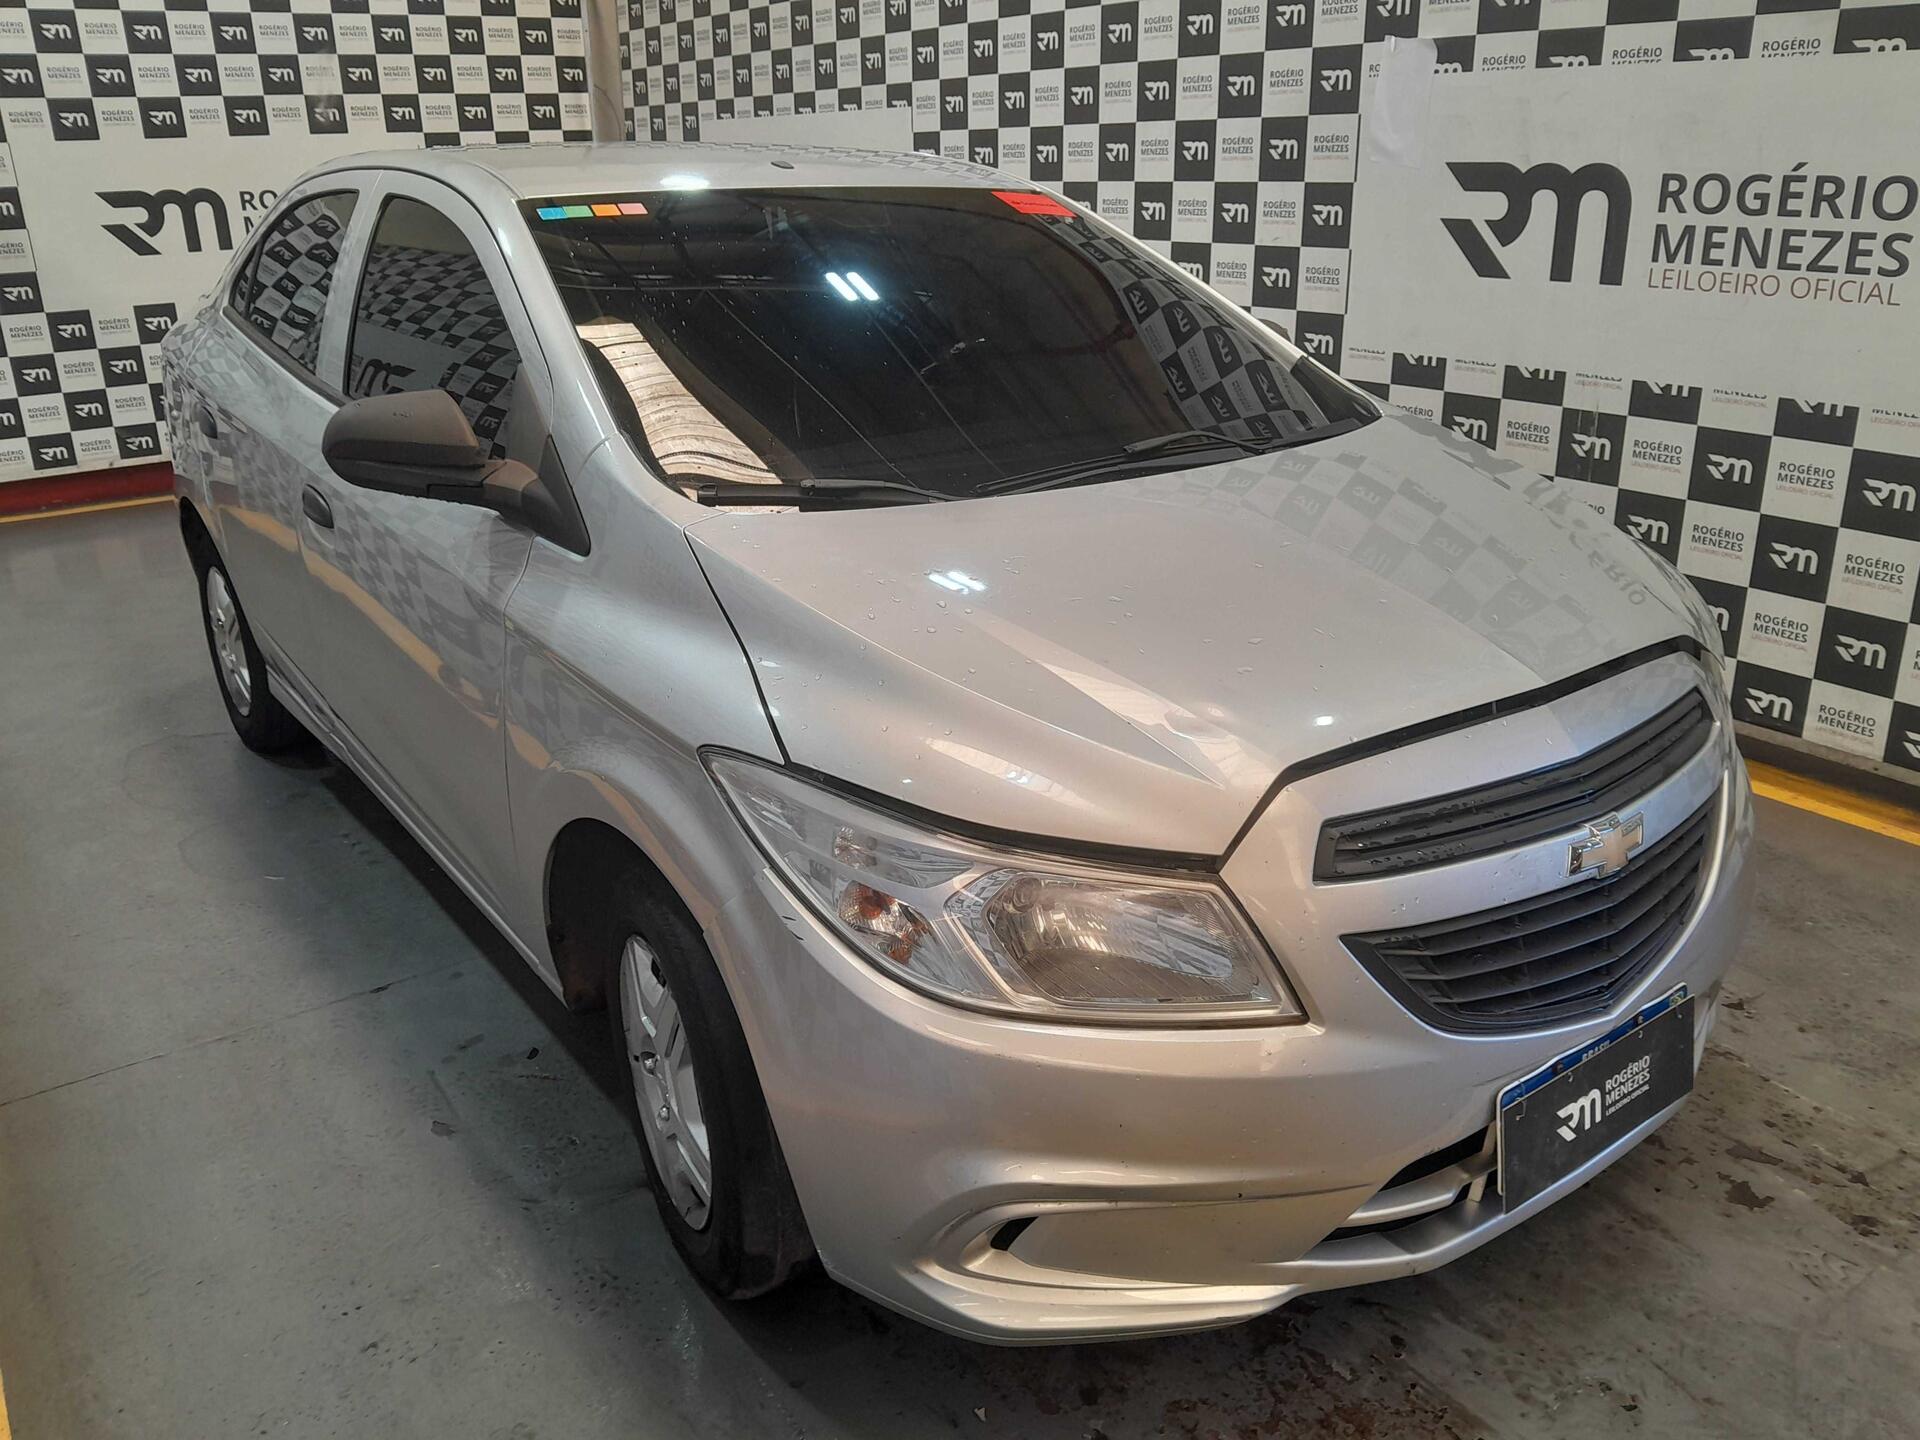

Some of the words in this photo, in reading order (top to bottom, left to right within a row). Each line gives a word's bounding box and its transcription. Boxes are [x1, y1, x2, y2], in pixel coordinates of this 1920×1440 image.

[1228, 6, 1260, 16] ROGÉRIO
[1321, 5, 1358, 16] MENEZES
[1144, 15, 1173, 25] ROGÉRIO
[1227, 15, 1260, 25] MENEZES
[1070, 24, 1095, 34] ROGÉRIO
[1144, 22, 1173, 33] MENEZES
[1003, 32, 1025, 41] ROGÉRIO
[1070, 32, 1095, 42] MENEZES
[1003, 40, 1025, 48] MENEZES
[1761, 37, 1821, 51] ROGÉRIO
[1612, 46, 1662, 60] ROGÉRIO
[1482, 54, 1526, 66] ROGÉRIO
[1270, 69, 1303, 78] ROGÉRIO
[1105, 80, 1131, 89] ROGÉRIO
[1183, 75, 1212, 84] ROGÉRIO
[1270, 78, 1303, 88] MENEZES
[1035, 86, 1059, 94] ROGÉRIO
[1182, 84, 1212, 92] MENEZES
[1141, 139, 1169, 147] ROGÉRIO
[1222, 136, 1253, 145] ROGÉRIO
[1314, 135, 1349, 144] ROGÉRIO
[1313, 143, 1349, 153] MENEZES
[1658, 162, 1918, 222] ROGÉRIO
[1102, 198, 1128, 206] ROGÉRIO
[1178, 199, 1207, 207] ROGÉRIO
[1264, 200, 1296, 209] ROGÉRIO
[1102, 206, 1128, 214] MENEZES
[1263, 210, 1296, 218] MENEZES
[1650, 224, 1914, 277] MENEZES
[1217, 260, 1247, 271] ROGÉRIO
[1216, 270, 1247, 279] MENEZES
[1306, 266, 1340, 276] ROGÉRIO
[1305, 276, 1340, 286] MENEZES
[1648, 268, 1780, 297] LEILOEIRO
[1790, 276, 1902, 306] OFICIAL
[1507, 420, 1550, 435] ROGÉRIO
[1506, 430, 1549, 444] MENEZES
[1634, 440, 1682, 454] ROGÉRIO
[1632, 450, 1681, 465] MENEZES
[1779, 462, 1835, 478] ROGÉRIO
[1778, 473, 1834, 490] MENEZES
[1693, 524, 1744, 541] ROGÉRIO
[1692, 534, 1743, 552] MENEZES
[1846, 554, 1905, 573] ROGÉRIO
[1844, 566, 1904, 585] MENEZES
[1755, 612, 1808, 632] ROGÉRIO
[1753, 623, 1808, 643] MENEZES
[1820, 704, 1876, 726] ROGÉRIO
[1818, 715, 1874, 738] MENEZES
[1606, 1056, 1650, 1092] ROGÉRIO
[1606, 1068, 1650, 1106] MENEZES
